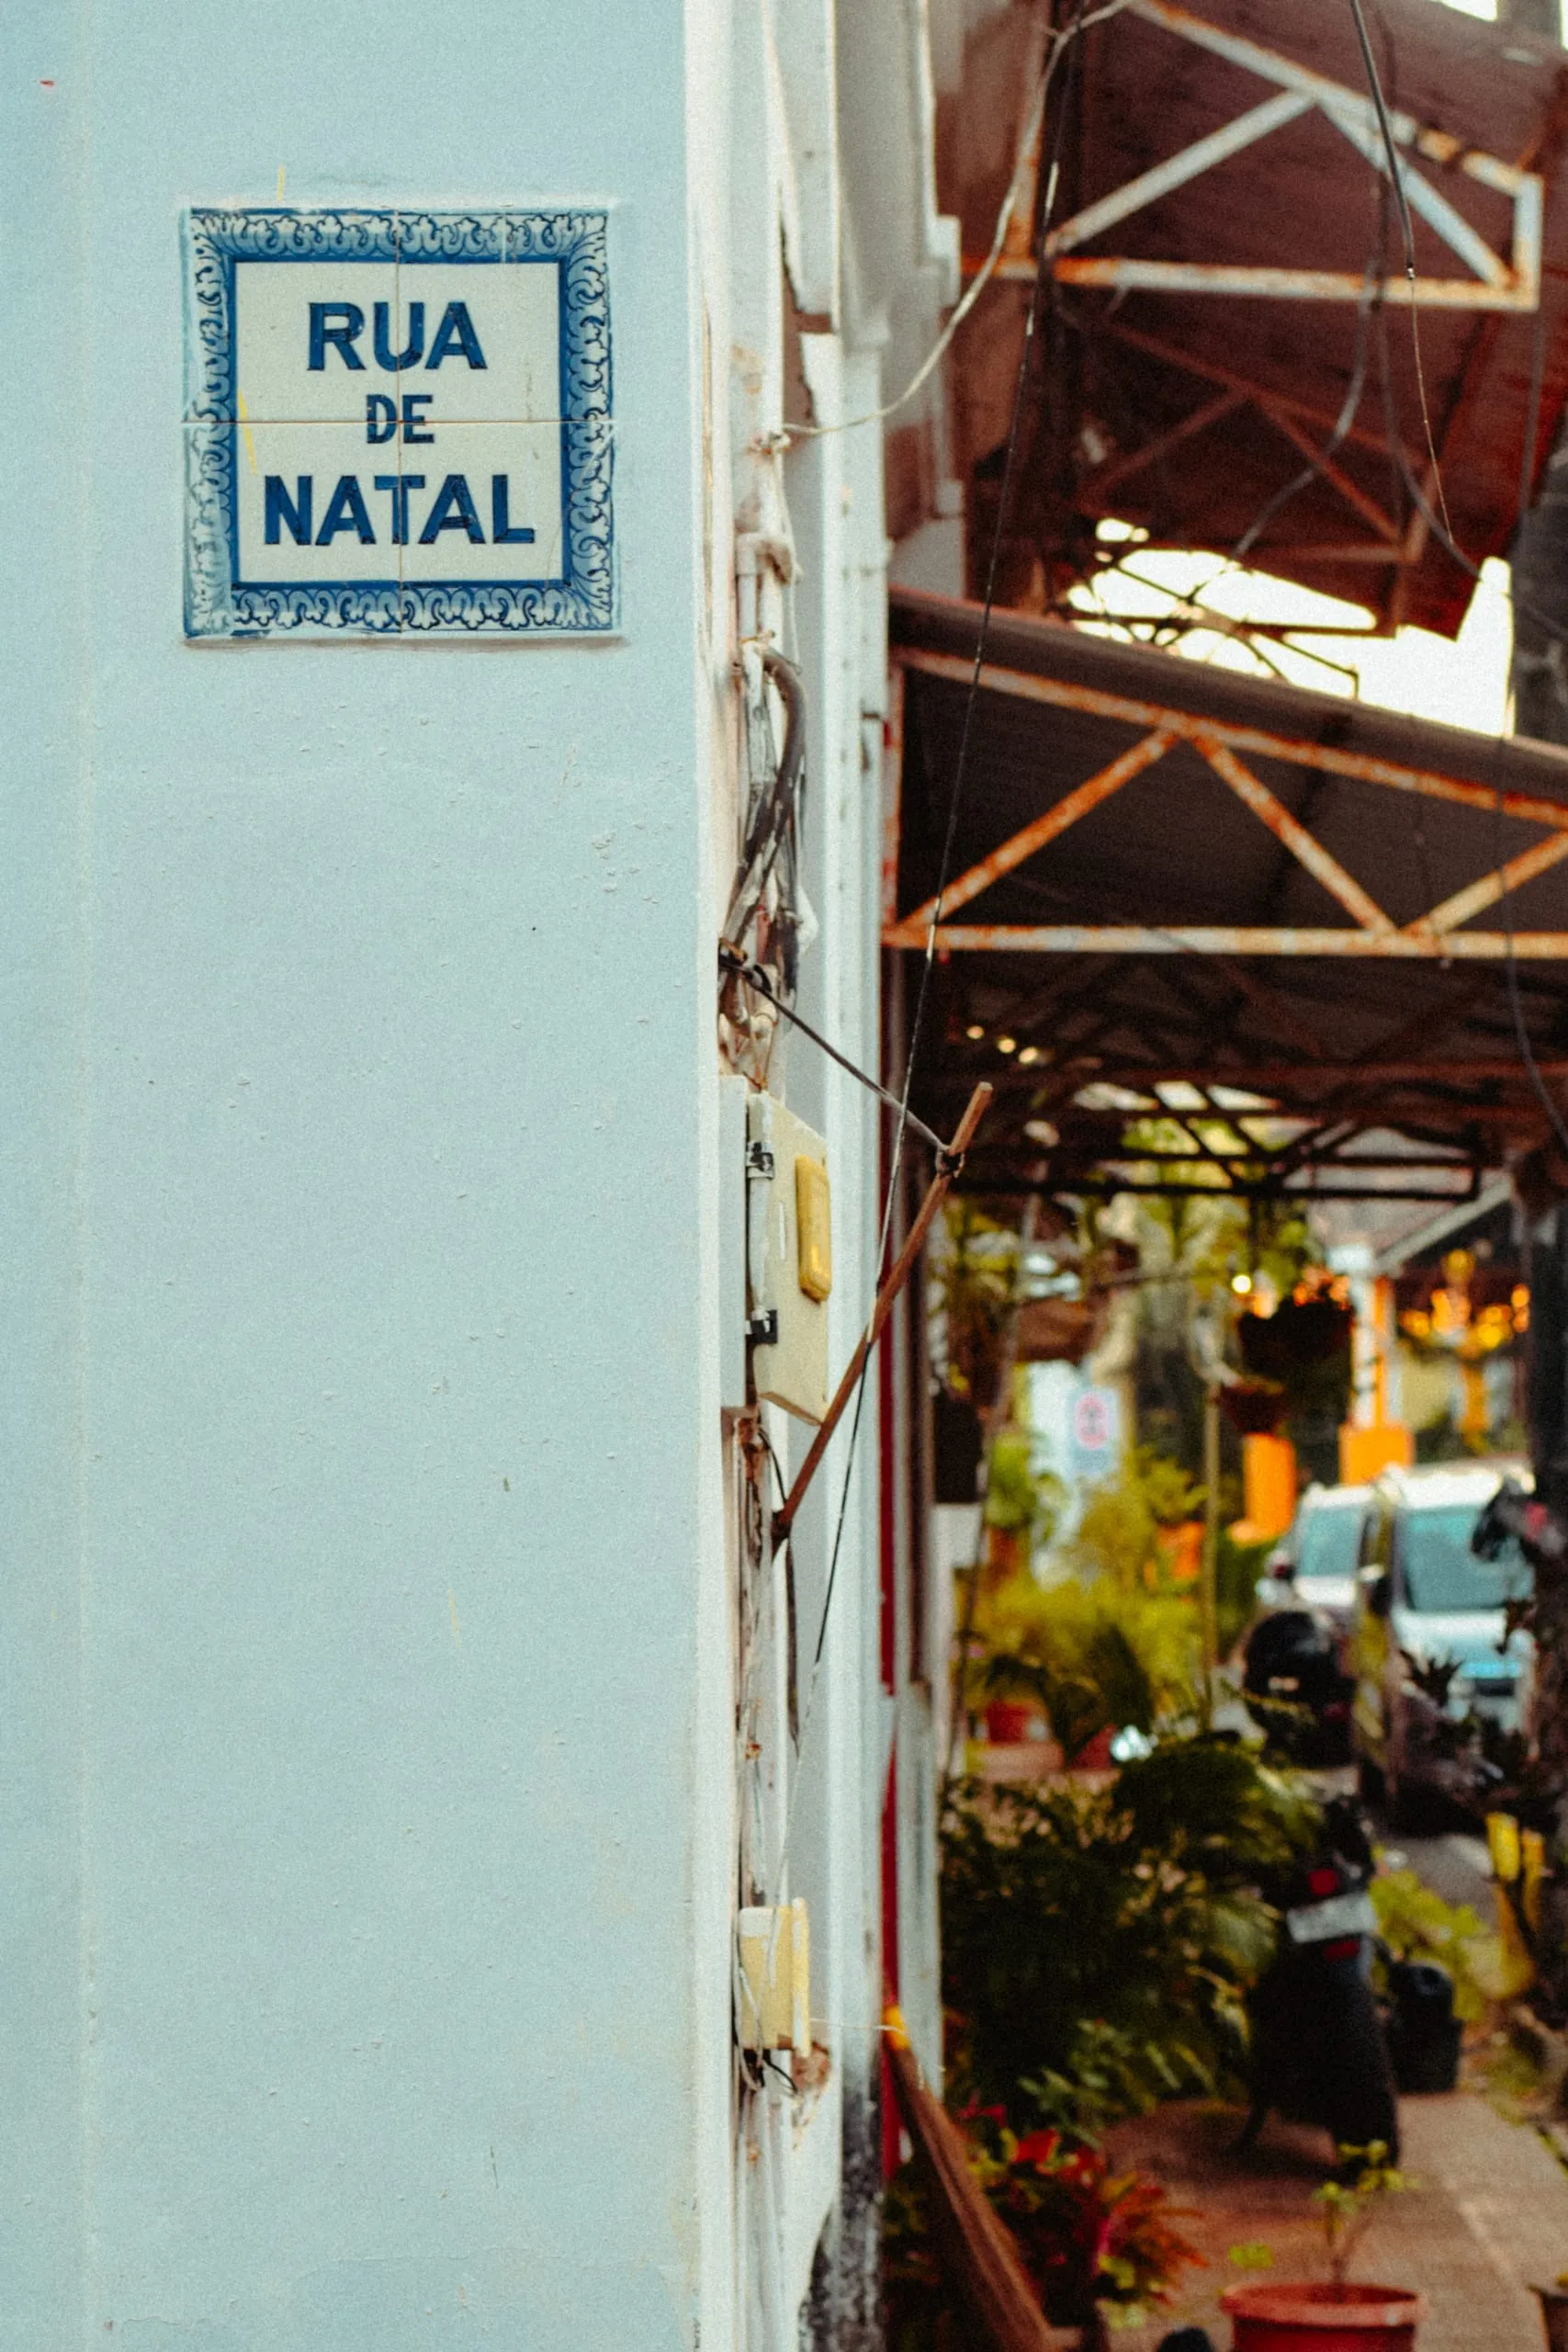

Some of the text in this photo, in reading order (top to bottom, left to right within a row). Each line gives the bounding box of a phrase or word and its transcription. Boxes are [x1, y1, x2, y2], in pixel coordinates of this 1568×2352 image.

[308, 301, 488, 372] RUA
[367, 394, 434, 445] DE
[264, 474, 535, 547] NATAL
